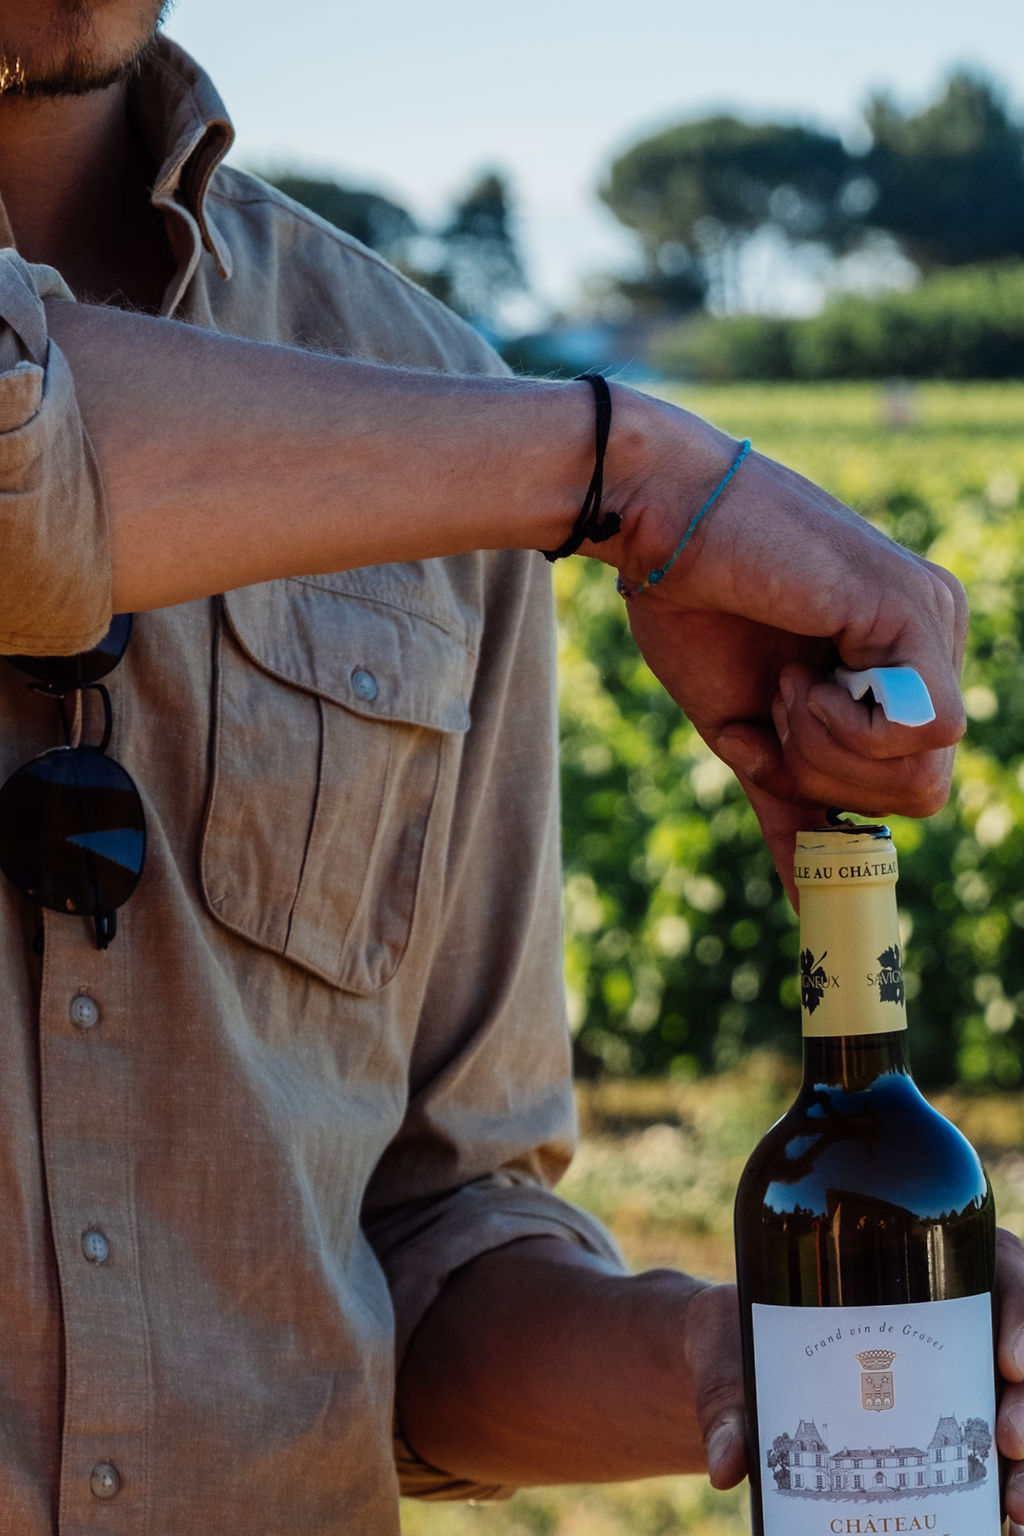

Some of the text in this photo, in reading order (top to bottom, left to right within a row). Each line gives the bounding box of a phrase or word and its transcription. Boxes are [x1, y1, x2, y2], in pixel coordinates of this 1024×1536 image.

[813, 867, 833, 879] AU
[804, 1321, 945, 1358] Grand vin de Graves
[830, 1513, 938, 1534] CHÂTEAU
